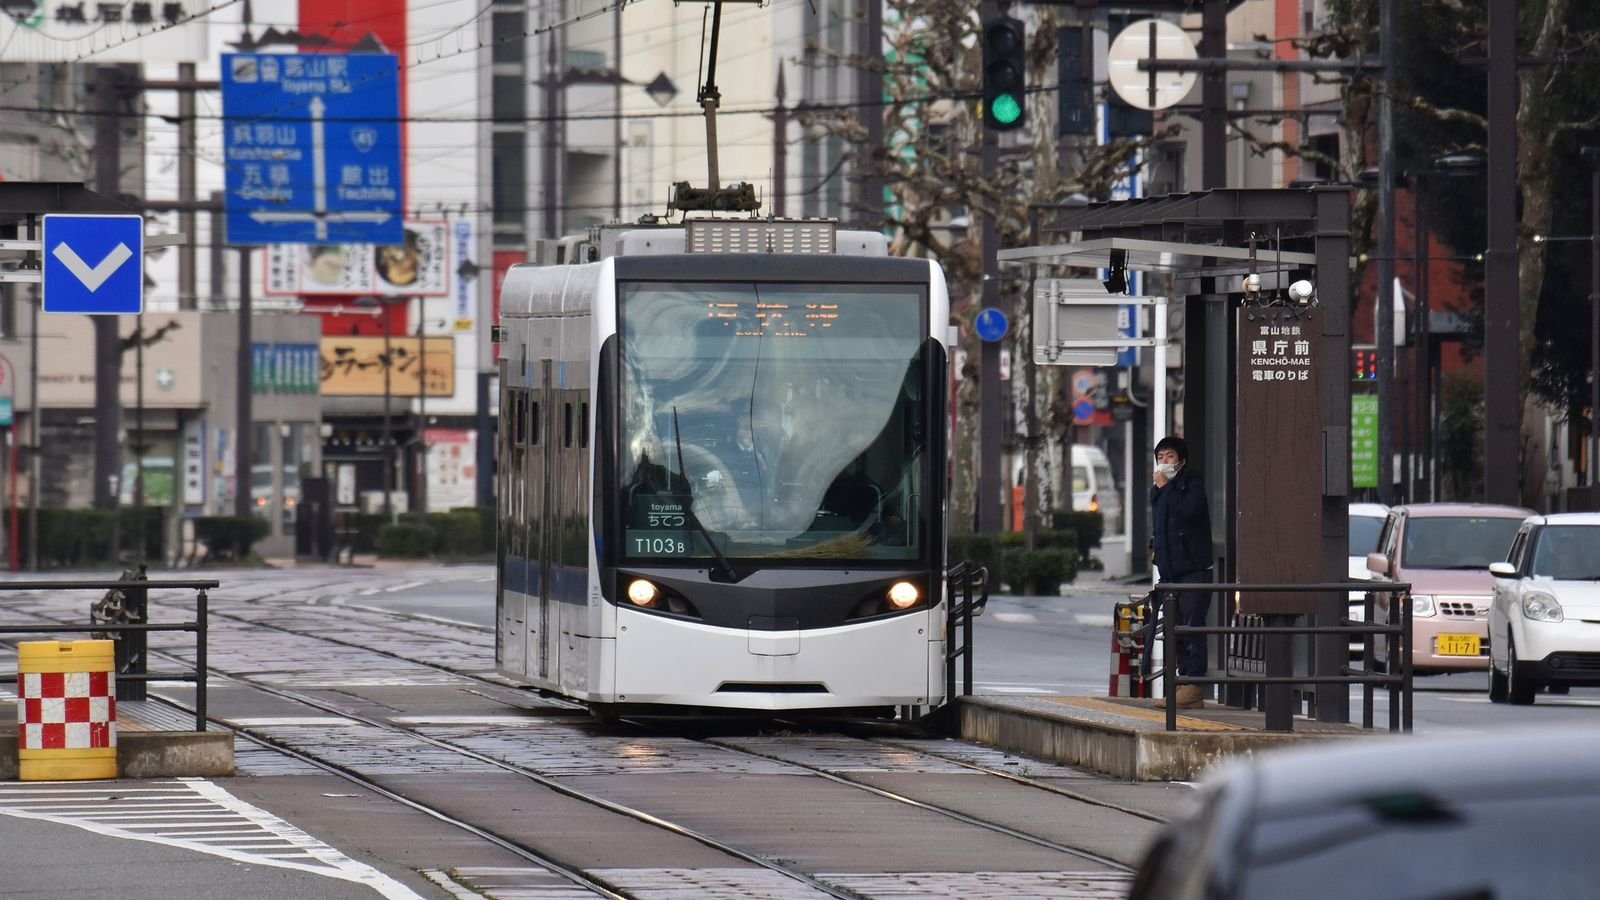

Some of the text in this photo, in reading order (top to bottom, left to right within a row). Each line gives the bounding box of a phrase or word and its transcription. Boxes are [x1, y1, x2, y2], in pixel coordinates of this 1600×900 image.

[1260, 326, 1301, 335] 富山地鉄
[1252, 340, 1309, 355] 県庁前
[1252, 369, 1309, 381] 電車のりば
[651, 504, 682, 512] toyama
[648, 515, 685, 527] ちてつ
